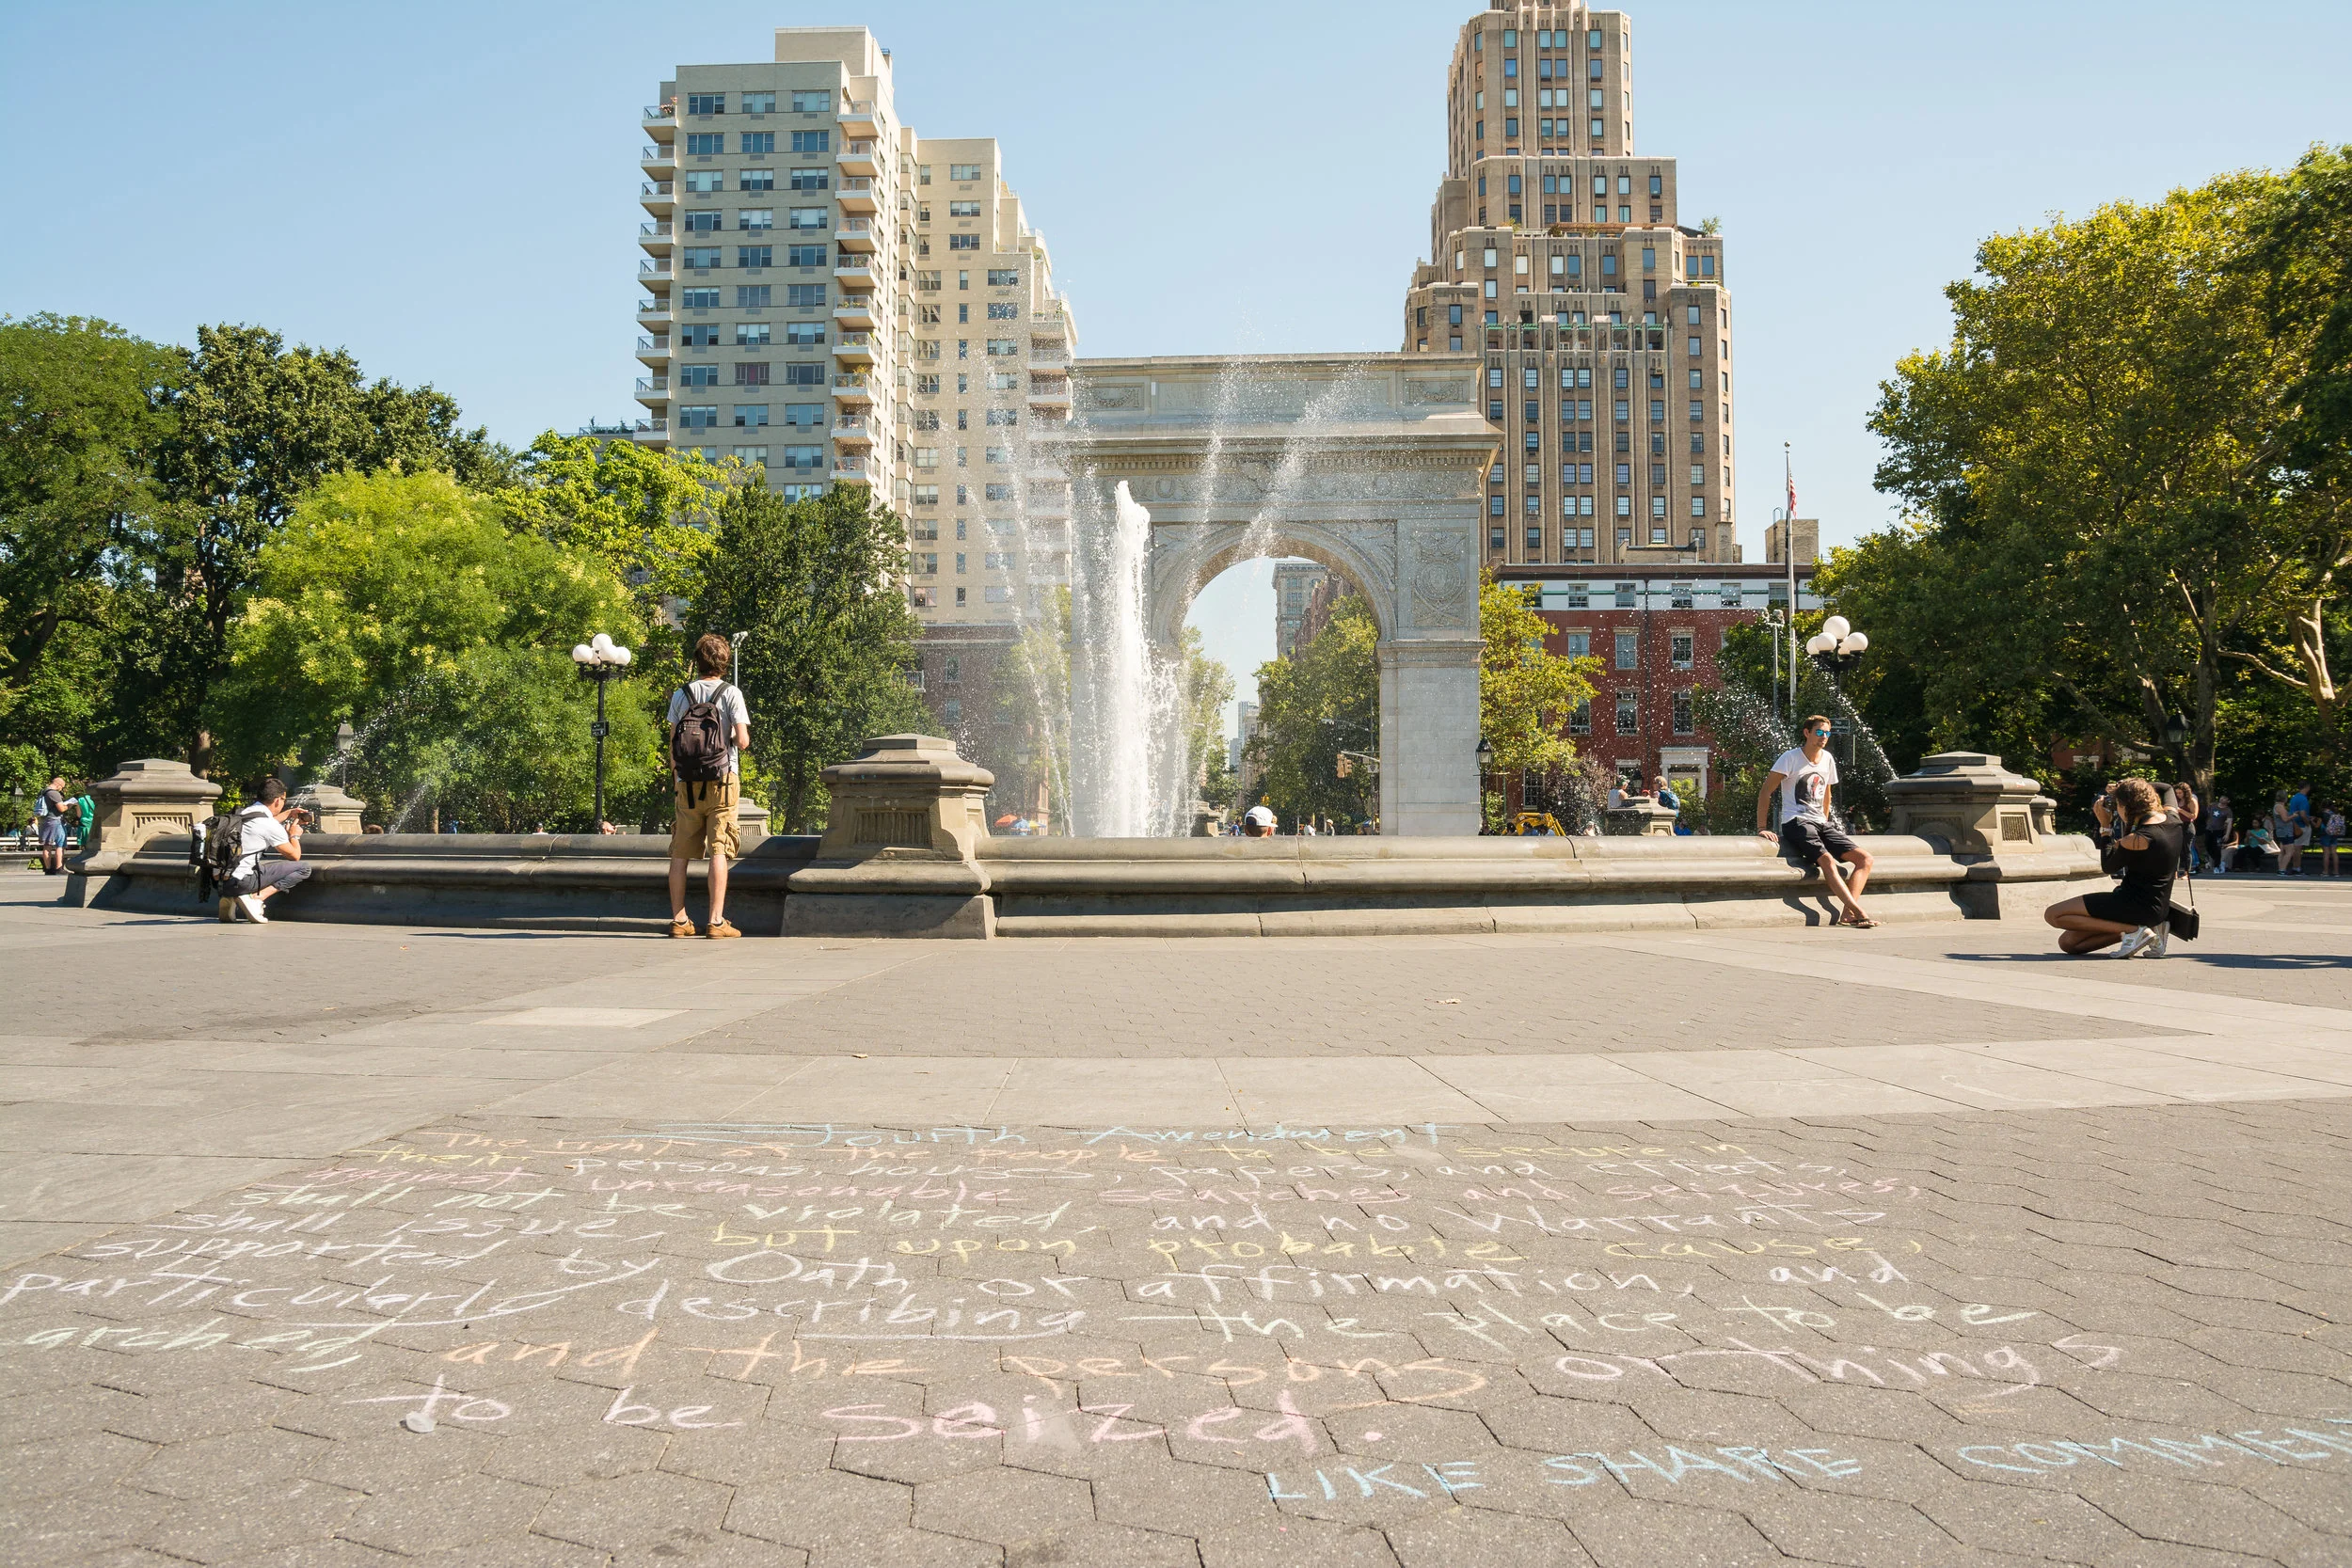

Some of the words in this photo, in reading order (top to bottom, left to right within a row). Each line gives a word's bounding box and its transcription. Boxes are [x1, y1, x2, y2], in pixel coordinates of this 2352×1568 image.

[417, 1132, 527, 1148] The
[532, 1137, 698, 1155] right
[815, 1145, 931, 1163] the
[1196, 1144, 1271, 1162] to
[1303, 1141, 1400, 1157] be
[1457, 1146, 1674, 1159] secure
[1691, 1140, 1747, 1155] in
[1066, 1122, 1462, 1145] Amendment
[1436, 1160, 1552, 1178] and
[1463, 1179, 1579, 1203] and
[244, 1183, 414, 1208] shall
[433, 1187, 564, 1211] not
[600, 1193, 697, 1219] be
[1151, 1202, 1273, 1232] and
[1319, 1213, 1408, 1232] no
[84, 1235, 509, 1273] supported
[706, 1250, 910, 1293] Oath
[977, 1276, 1089, 1298] or
[1768, 1250, 1910, 1286] and
[146, 1209, 346, 1234] shall
[711, 1220, 860, 1253] but
[897, 1238, 1078, 1263] upon
[1151, 1231, 1530, 1270] probable
[0, 1265, 564, 1327] particularly
[617, 1281, 1087, 1340] describing
[1118, 1301, 1401, 1344] the
[1422, 1299, 1691, 1353] place
[1722, 1294, 1836, 1334] to
[1856, 1291, 2042, 1325] be
[442, 1324, 660, 1379] and
[680, 1329, 929, 1381] the
[1556, 1354, 1670, 1382] or
[1672, 1335, 2122, 1399] things
[341, 1374, 513, 1423] to
[601, 1385, 746, 1430] be
[1266, 1460, 1485, 1500] LIKE
[1543, 1445, 1862, 1484] SHARE
[1957, 1418, 2352, 1475] COMMEN
